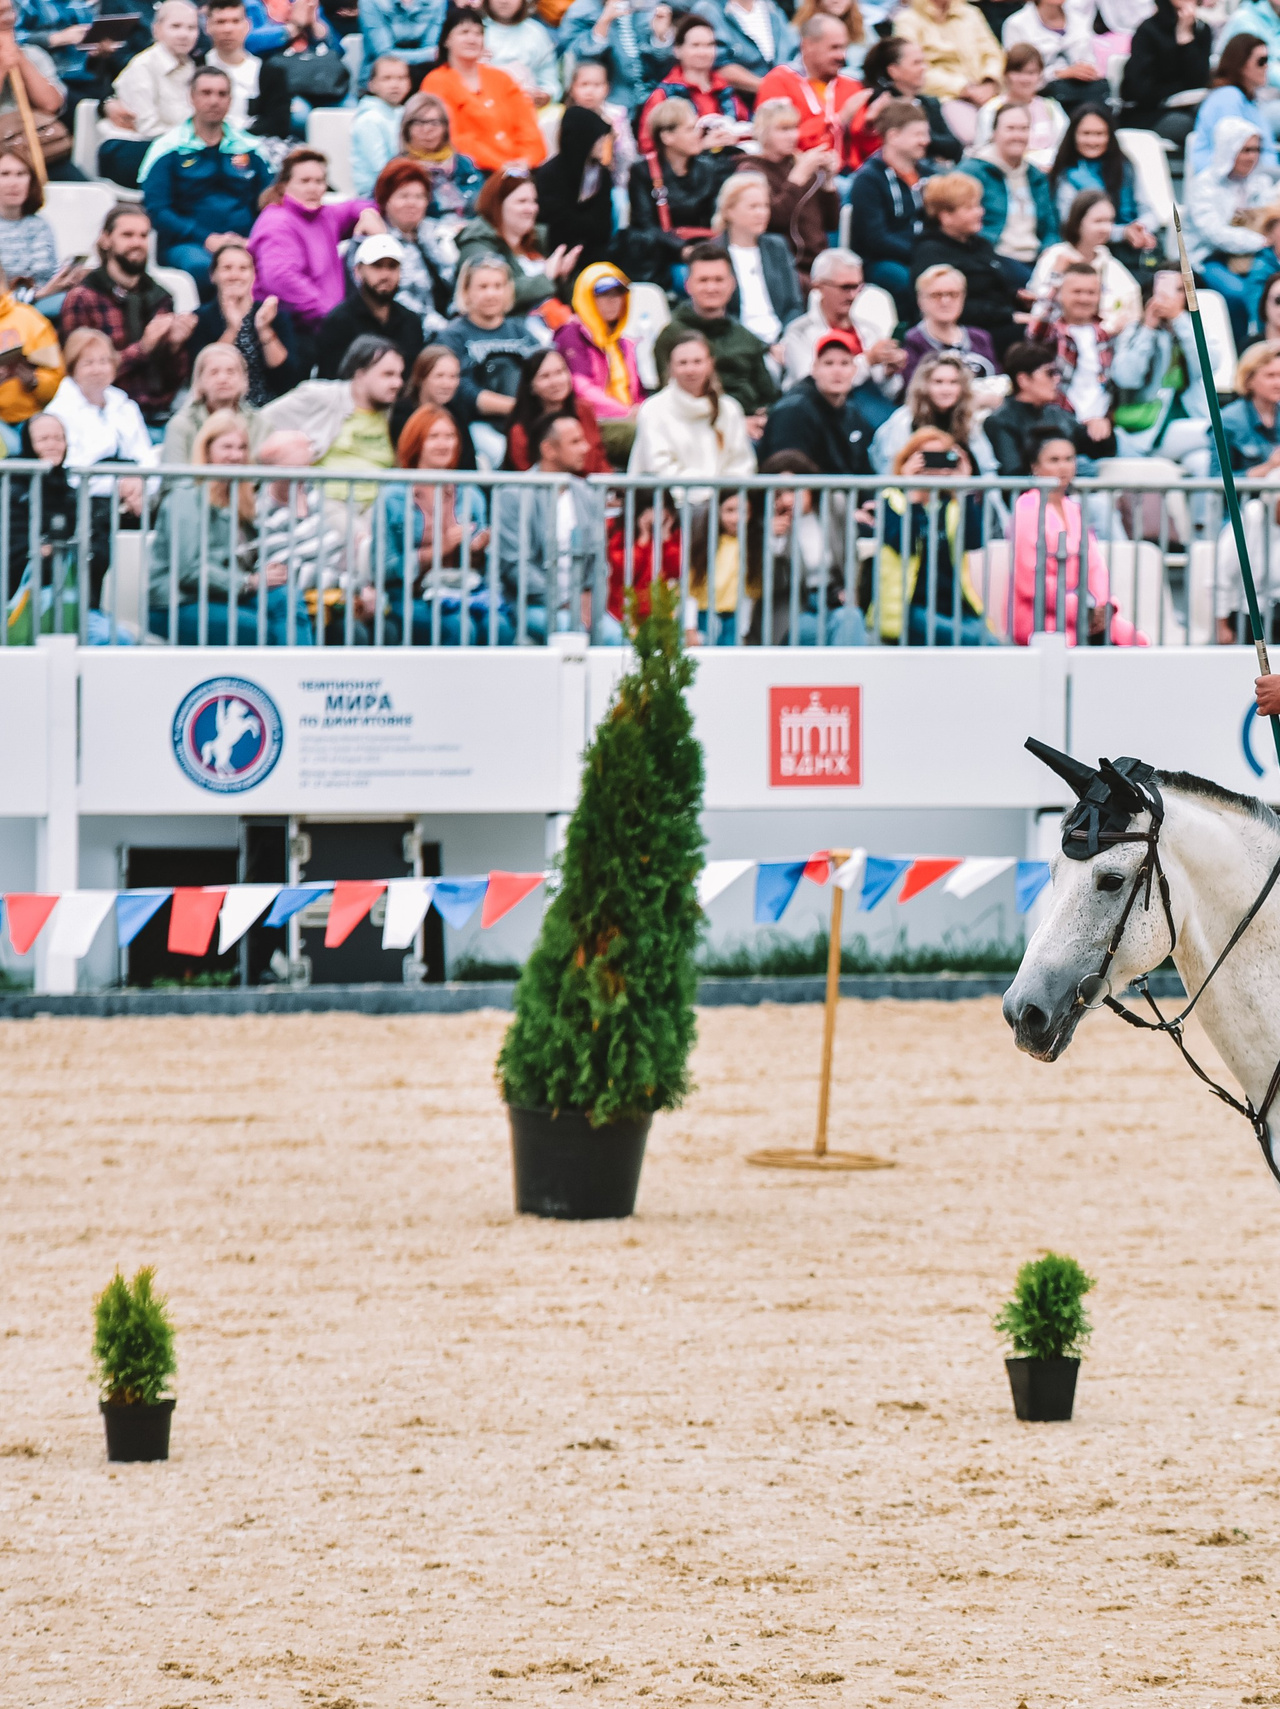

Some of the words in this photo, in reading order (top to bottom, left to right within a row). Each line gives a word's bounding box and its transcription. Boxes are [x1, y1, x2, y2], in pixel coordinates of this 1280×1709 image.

[325, 693, 392, 711] МИРА
[299, 715, 318, 728] ПО
[780, 754, 851, 777] ВДНХ
